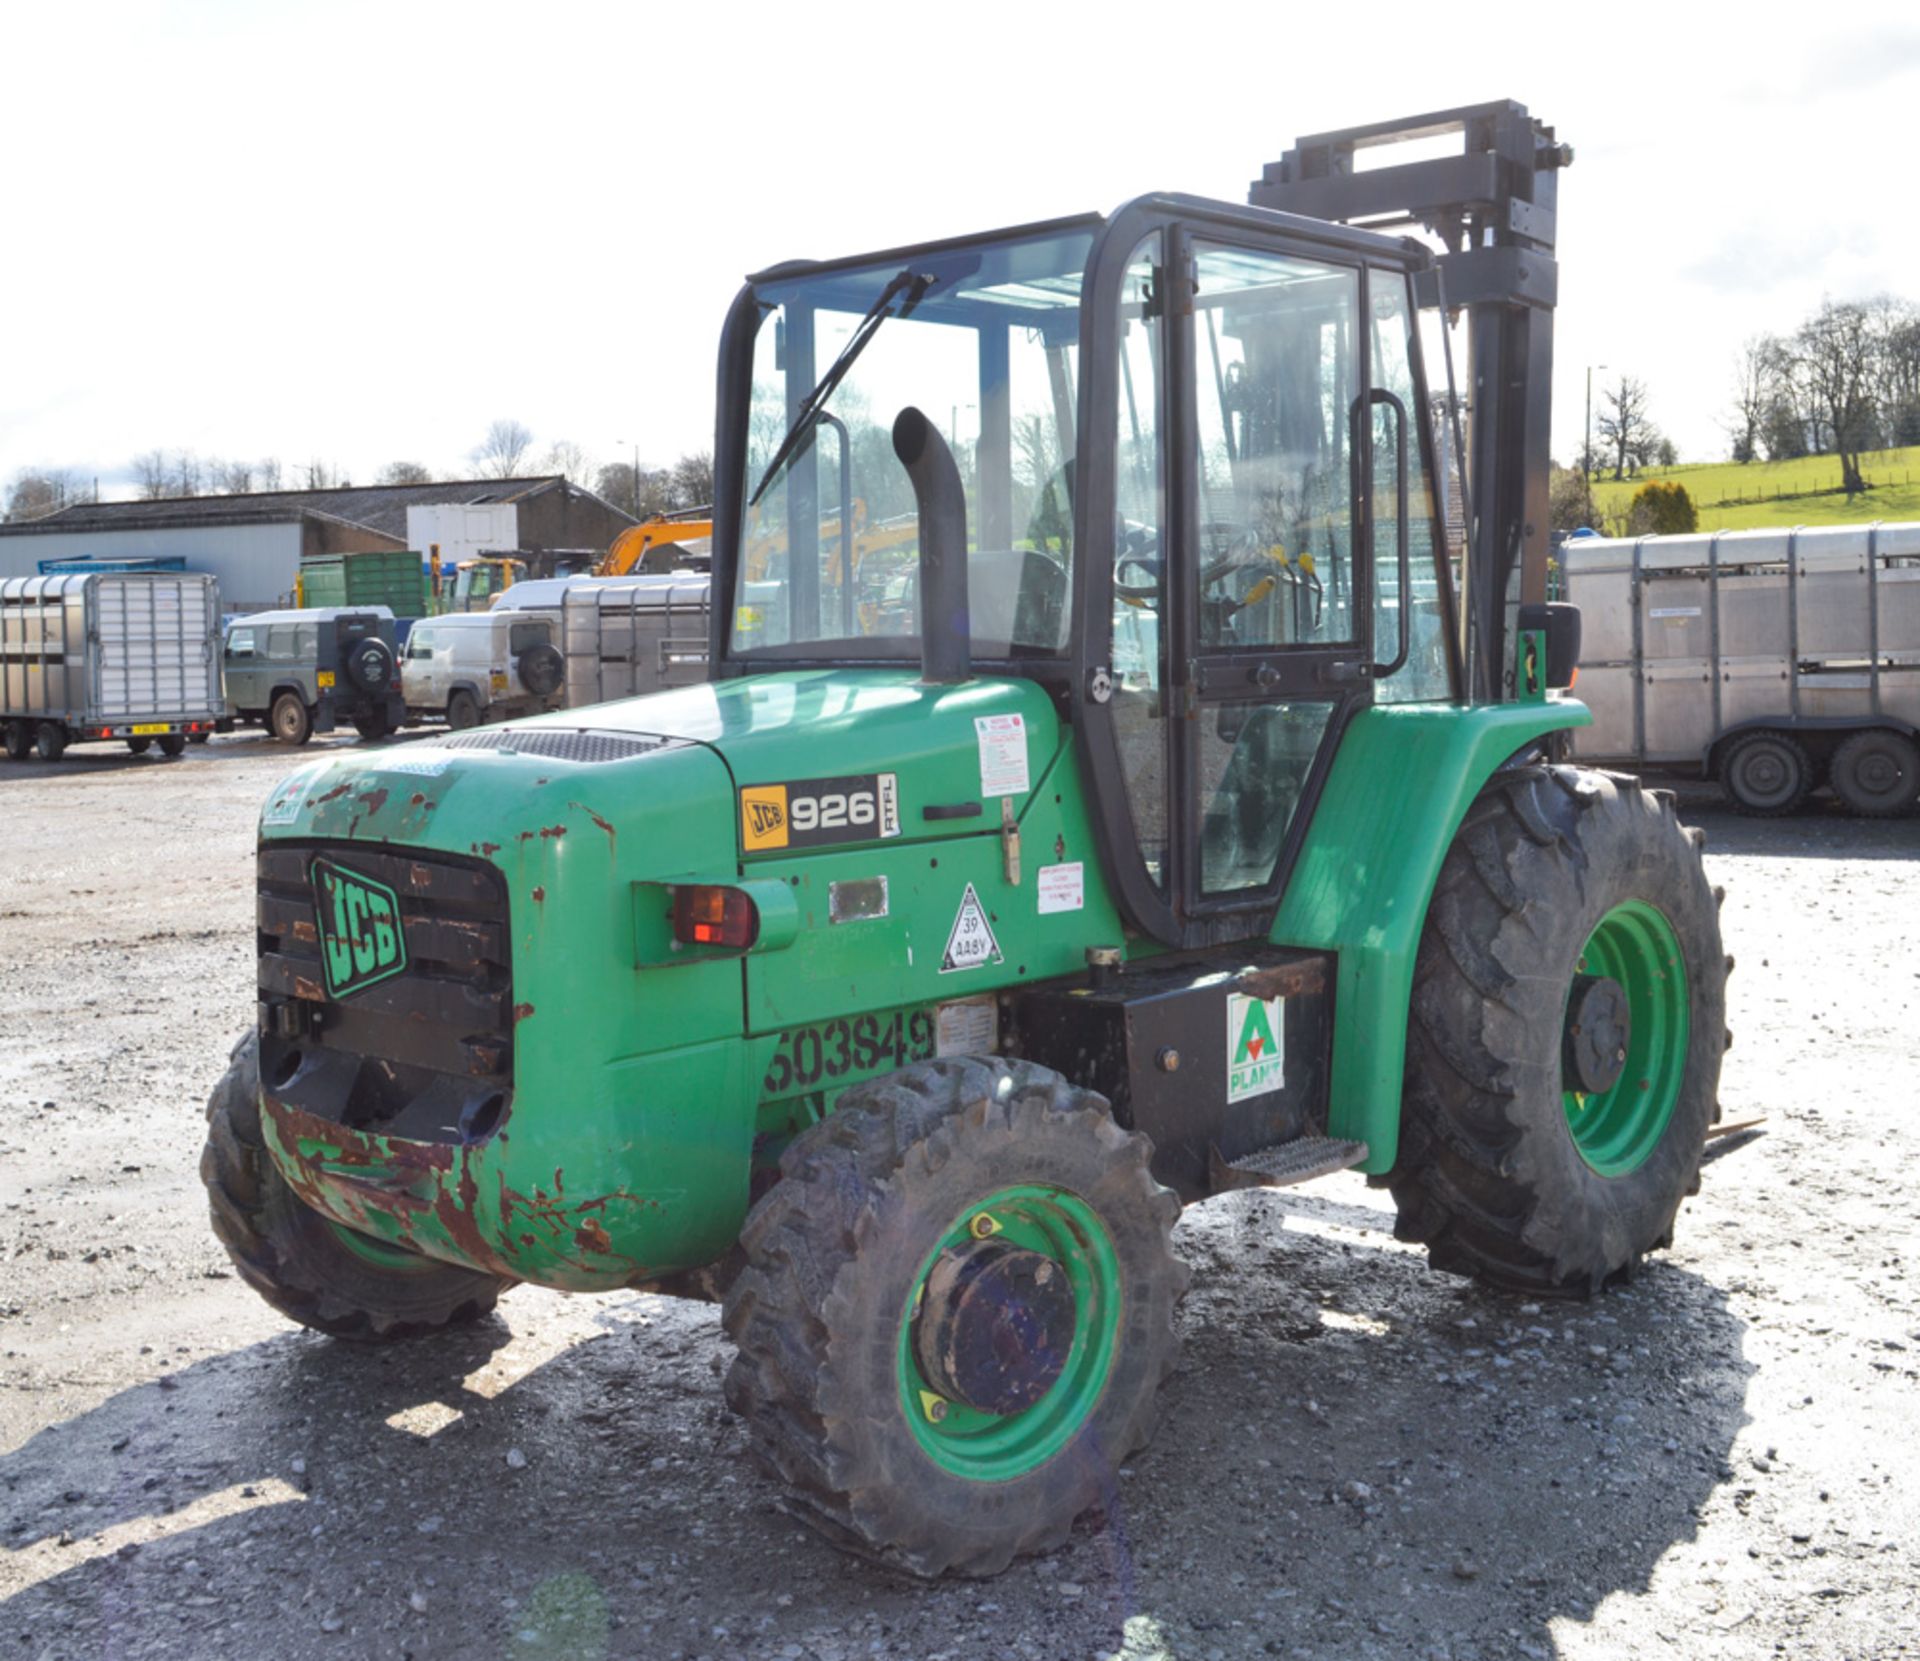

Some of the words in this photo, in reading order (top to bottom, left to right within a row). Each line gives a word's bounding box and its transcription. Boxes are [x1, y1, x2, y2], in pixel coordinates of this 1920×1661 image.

[752, 803, 783, 833] JCB
[791, 791, 876, 831] 926
[882, 778, 895, 831] RTFL
[323, 871, 397, 987] JCB
[963, 916, 978, 934] 39
